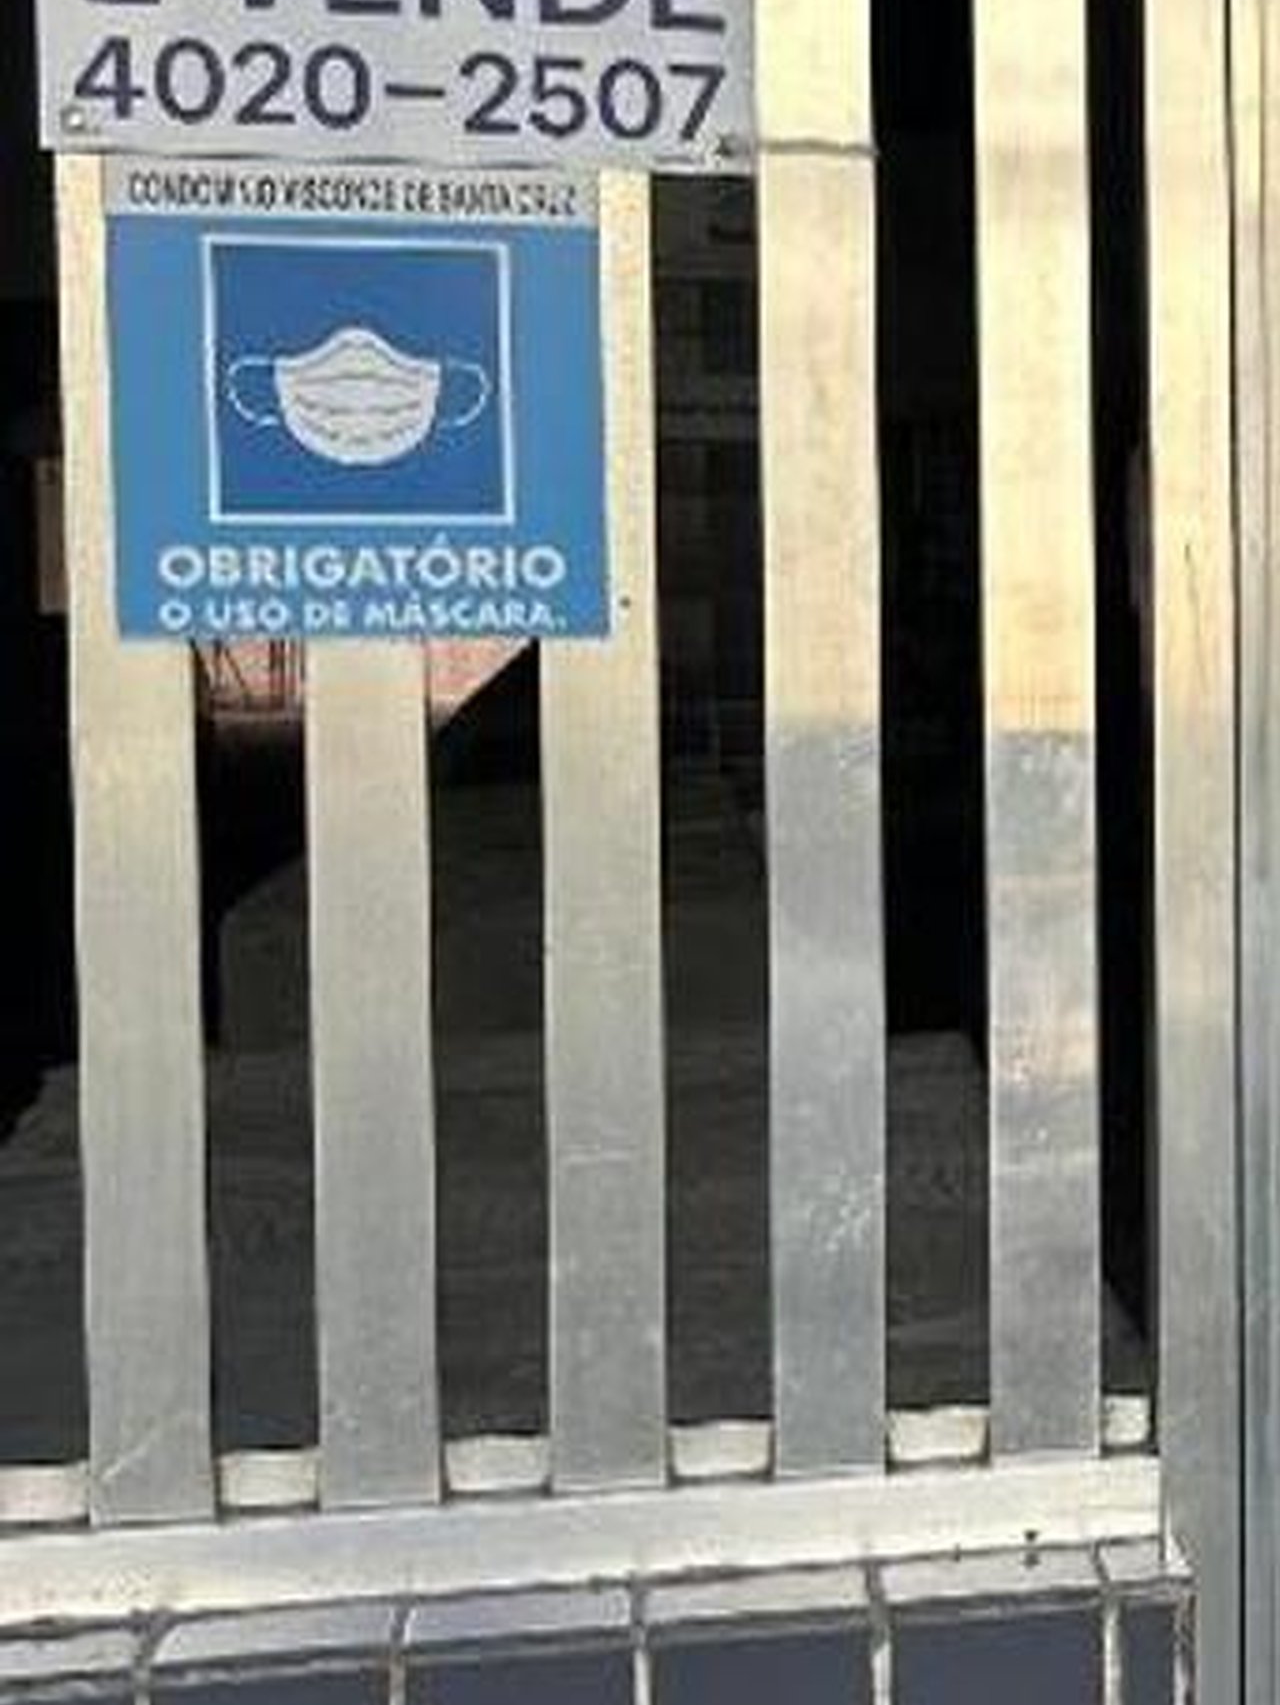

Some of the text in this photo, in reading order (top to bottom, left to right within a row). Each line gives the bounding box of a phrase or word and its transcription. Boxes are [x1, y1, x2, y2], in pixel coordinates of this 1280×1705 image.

[73, 36, 729, 141] 4020-2507
[158, 532, 566, 590] OBRIGATÓRIO
[158, 601, 191, 630] O
[206, 599, 289, 631] USO
[303, 601, 349, 629] DE
